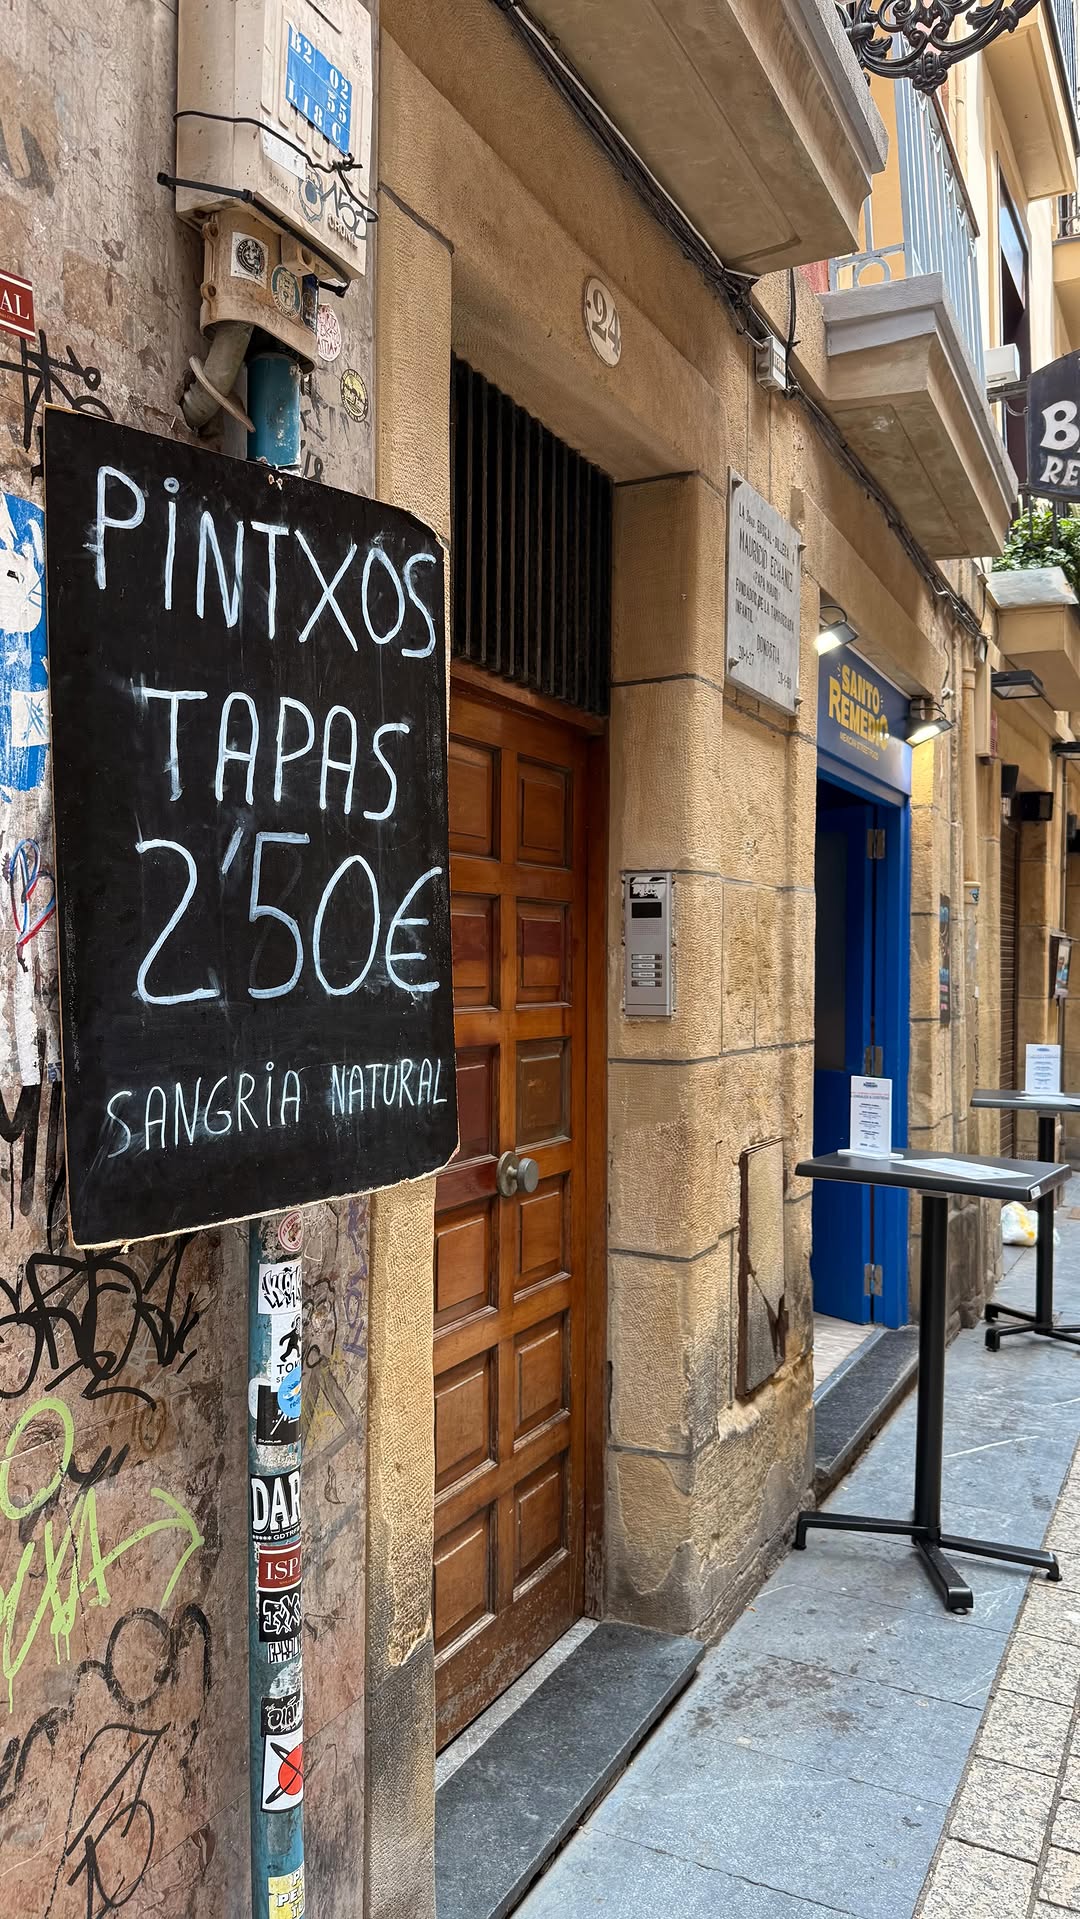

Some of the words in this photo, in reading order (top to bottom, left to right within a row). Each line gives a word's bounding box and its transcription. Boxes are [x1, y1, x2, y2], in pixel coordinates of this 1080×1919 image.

[592, 288, 620, 357] 24
[828, 675, 889, 751] REMEDIO
[841, 664, 880, 715] SANTO
[140, 685, 410, 821] TAPAS
[135, 828, 442, 1005] 2'50€
[330, 1058, 448, 1115] NATURAL
